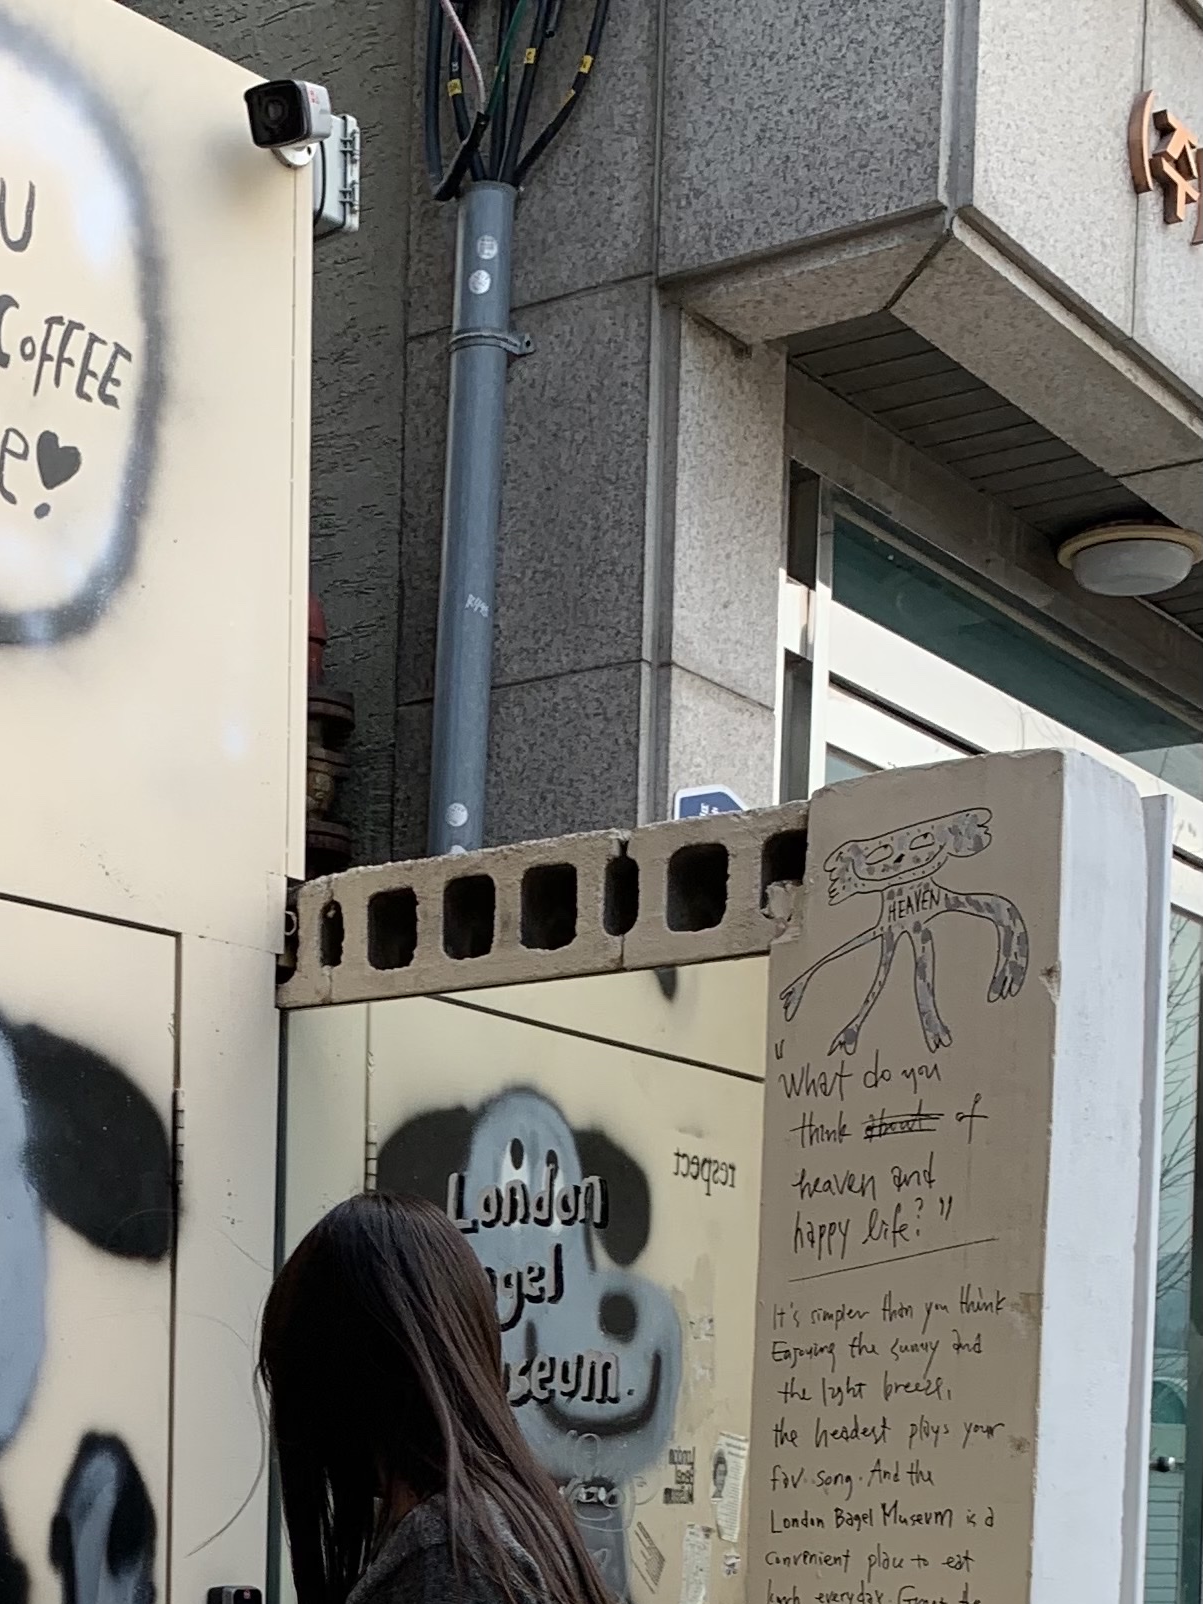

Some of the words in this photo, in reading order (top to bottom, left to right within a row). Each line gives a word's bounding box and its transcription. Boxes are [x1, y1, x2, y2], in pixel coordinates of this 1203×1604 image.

[887, 888, 941, 923] HEAVEN
[863, 1048, 892, 1089] do
[901, 1063, 941, 1095] you
[789, 1110, 852, 1148] think
[955, 1092, 989, 1145] of
[791, 1167, 877, 1201] heaven
[890, 1151, 936, 1192] and
[446, 1162, 609, 1234] London
[793, 1210, 851, 1261] happy
[484, 1242, 565, 1333] gel
[772, 1301, 800, 1331] It's
[882, 1290, 914, 1323] than
[921, 1301, 950, 1336] you
[959, 1283, 1006, 1314] think
[848, 1331, 879, 1359] the
[951, 1328, 983, 1355] and
[777, 1376, 812, 1404] the
[773, 1416, 798, 1448] the
[868, 1458, 900, 1487] And
[906, 1459, 936, 1487] the
[770, 1509, 825, 1534] London
[834, 1507, 874, 1532] Bagel
[881, 1499, 953, 1528] Museum
[965, 1508, 977, 1528] is
[984, 1506, 995, 1528] a
[867, 1543, 904, 1583] place
[910, 1554, 930, 1569] to
[941, 1549, 976, 1573] eat
